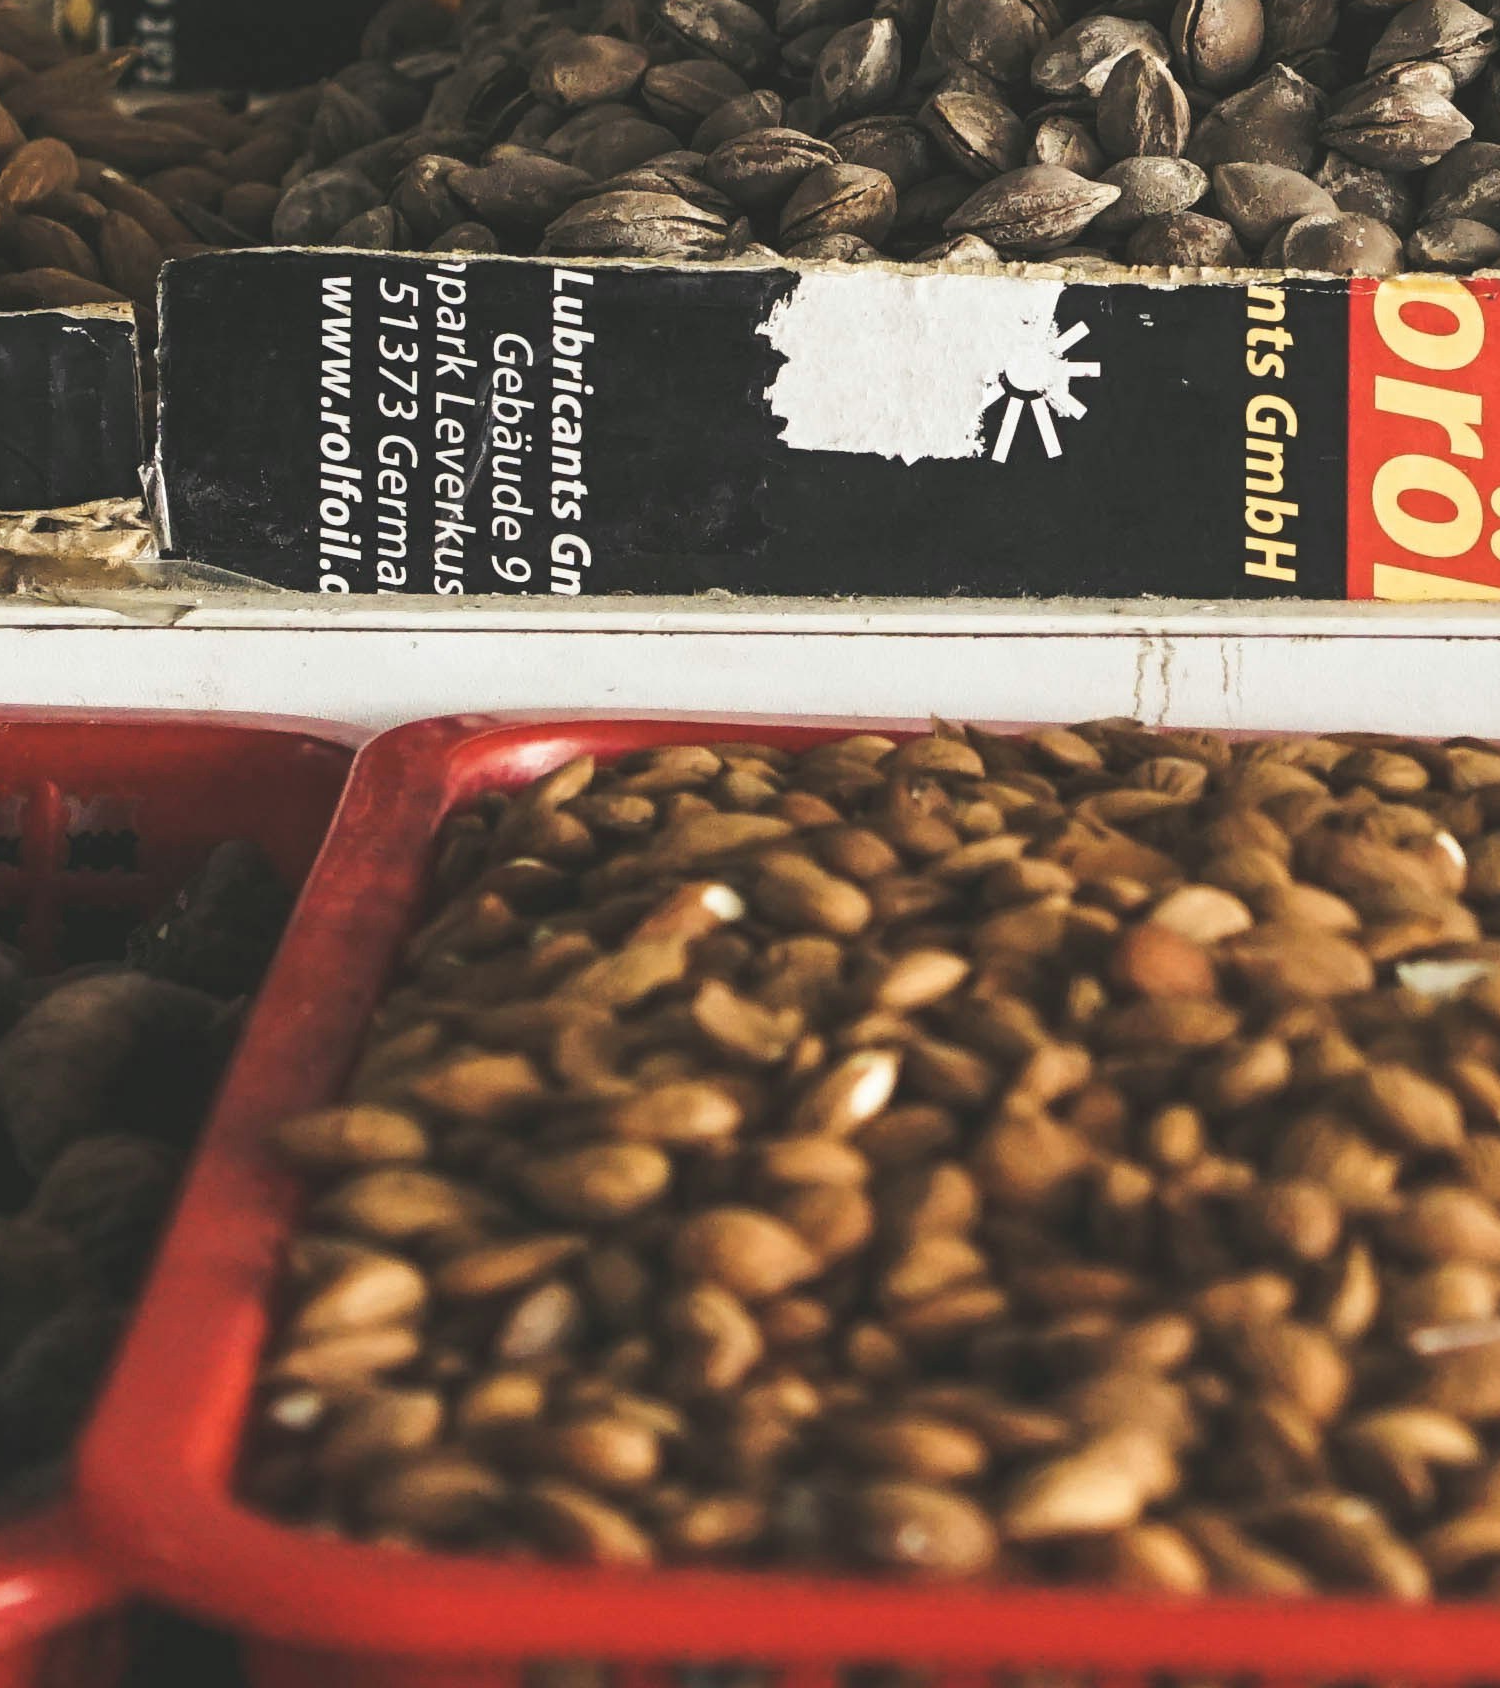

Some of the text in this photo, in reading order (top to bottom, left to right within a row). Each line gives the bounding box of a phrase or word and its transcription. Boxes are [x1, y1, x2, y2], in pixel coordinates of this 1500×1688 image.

[377, 277, 419, 594] 51373 Germa
[491, 333, 534, 541] Gebäude
[551, 269, 595, 521] Lubricants
[1244, 394, 1299, 582] GmbH
